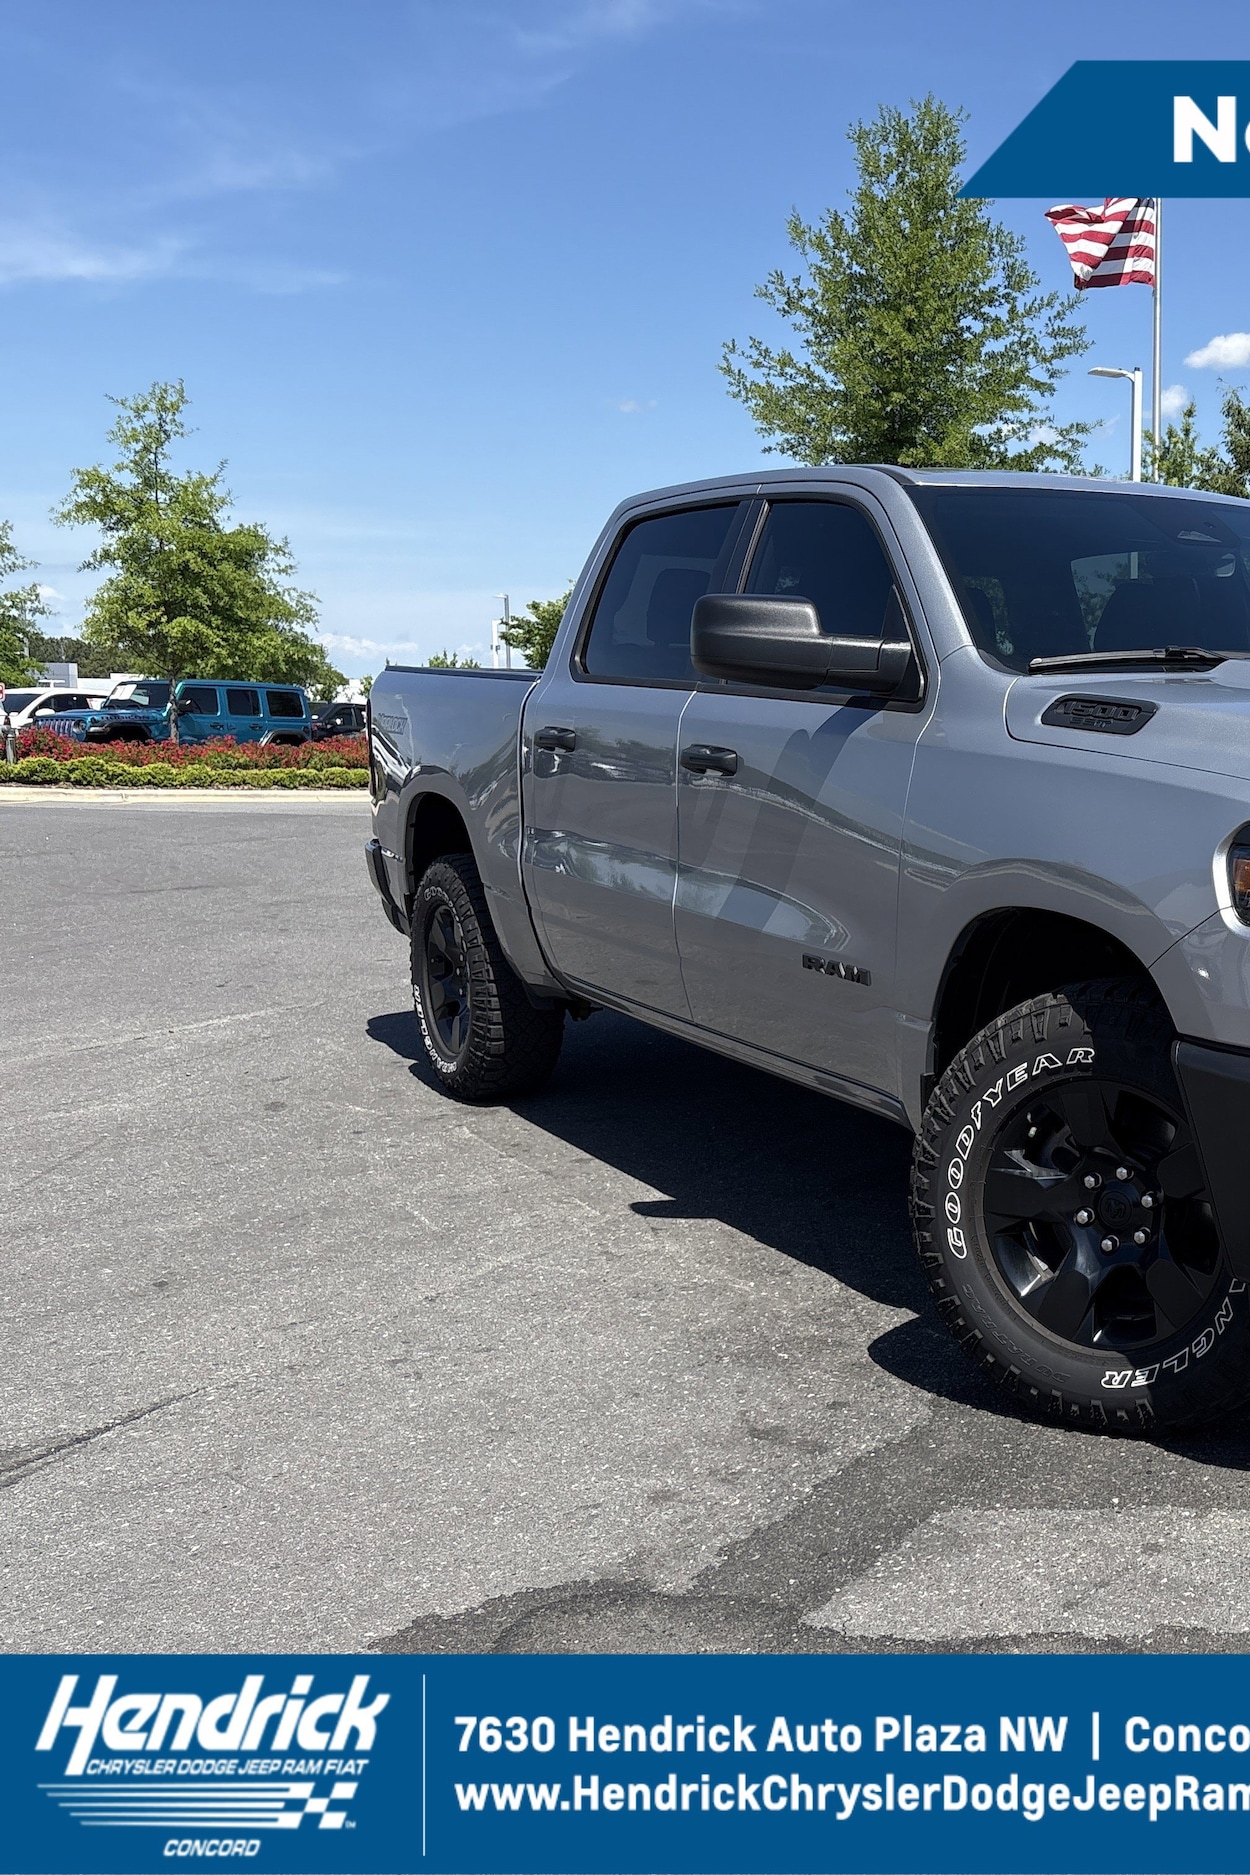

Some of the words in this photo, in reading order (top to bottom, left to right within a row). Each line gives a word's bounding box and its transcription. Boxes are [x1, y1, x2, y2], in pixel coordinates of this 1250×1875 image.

[1055, 701, 1140, 721] 1500
[802, 952, 872, 987] RAM
[944, 1047, 1095, 1260] GOODYEAR
